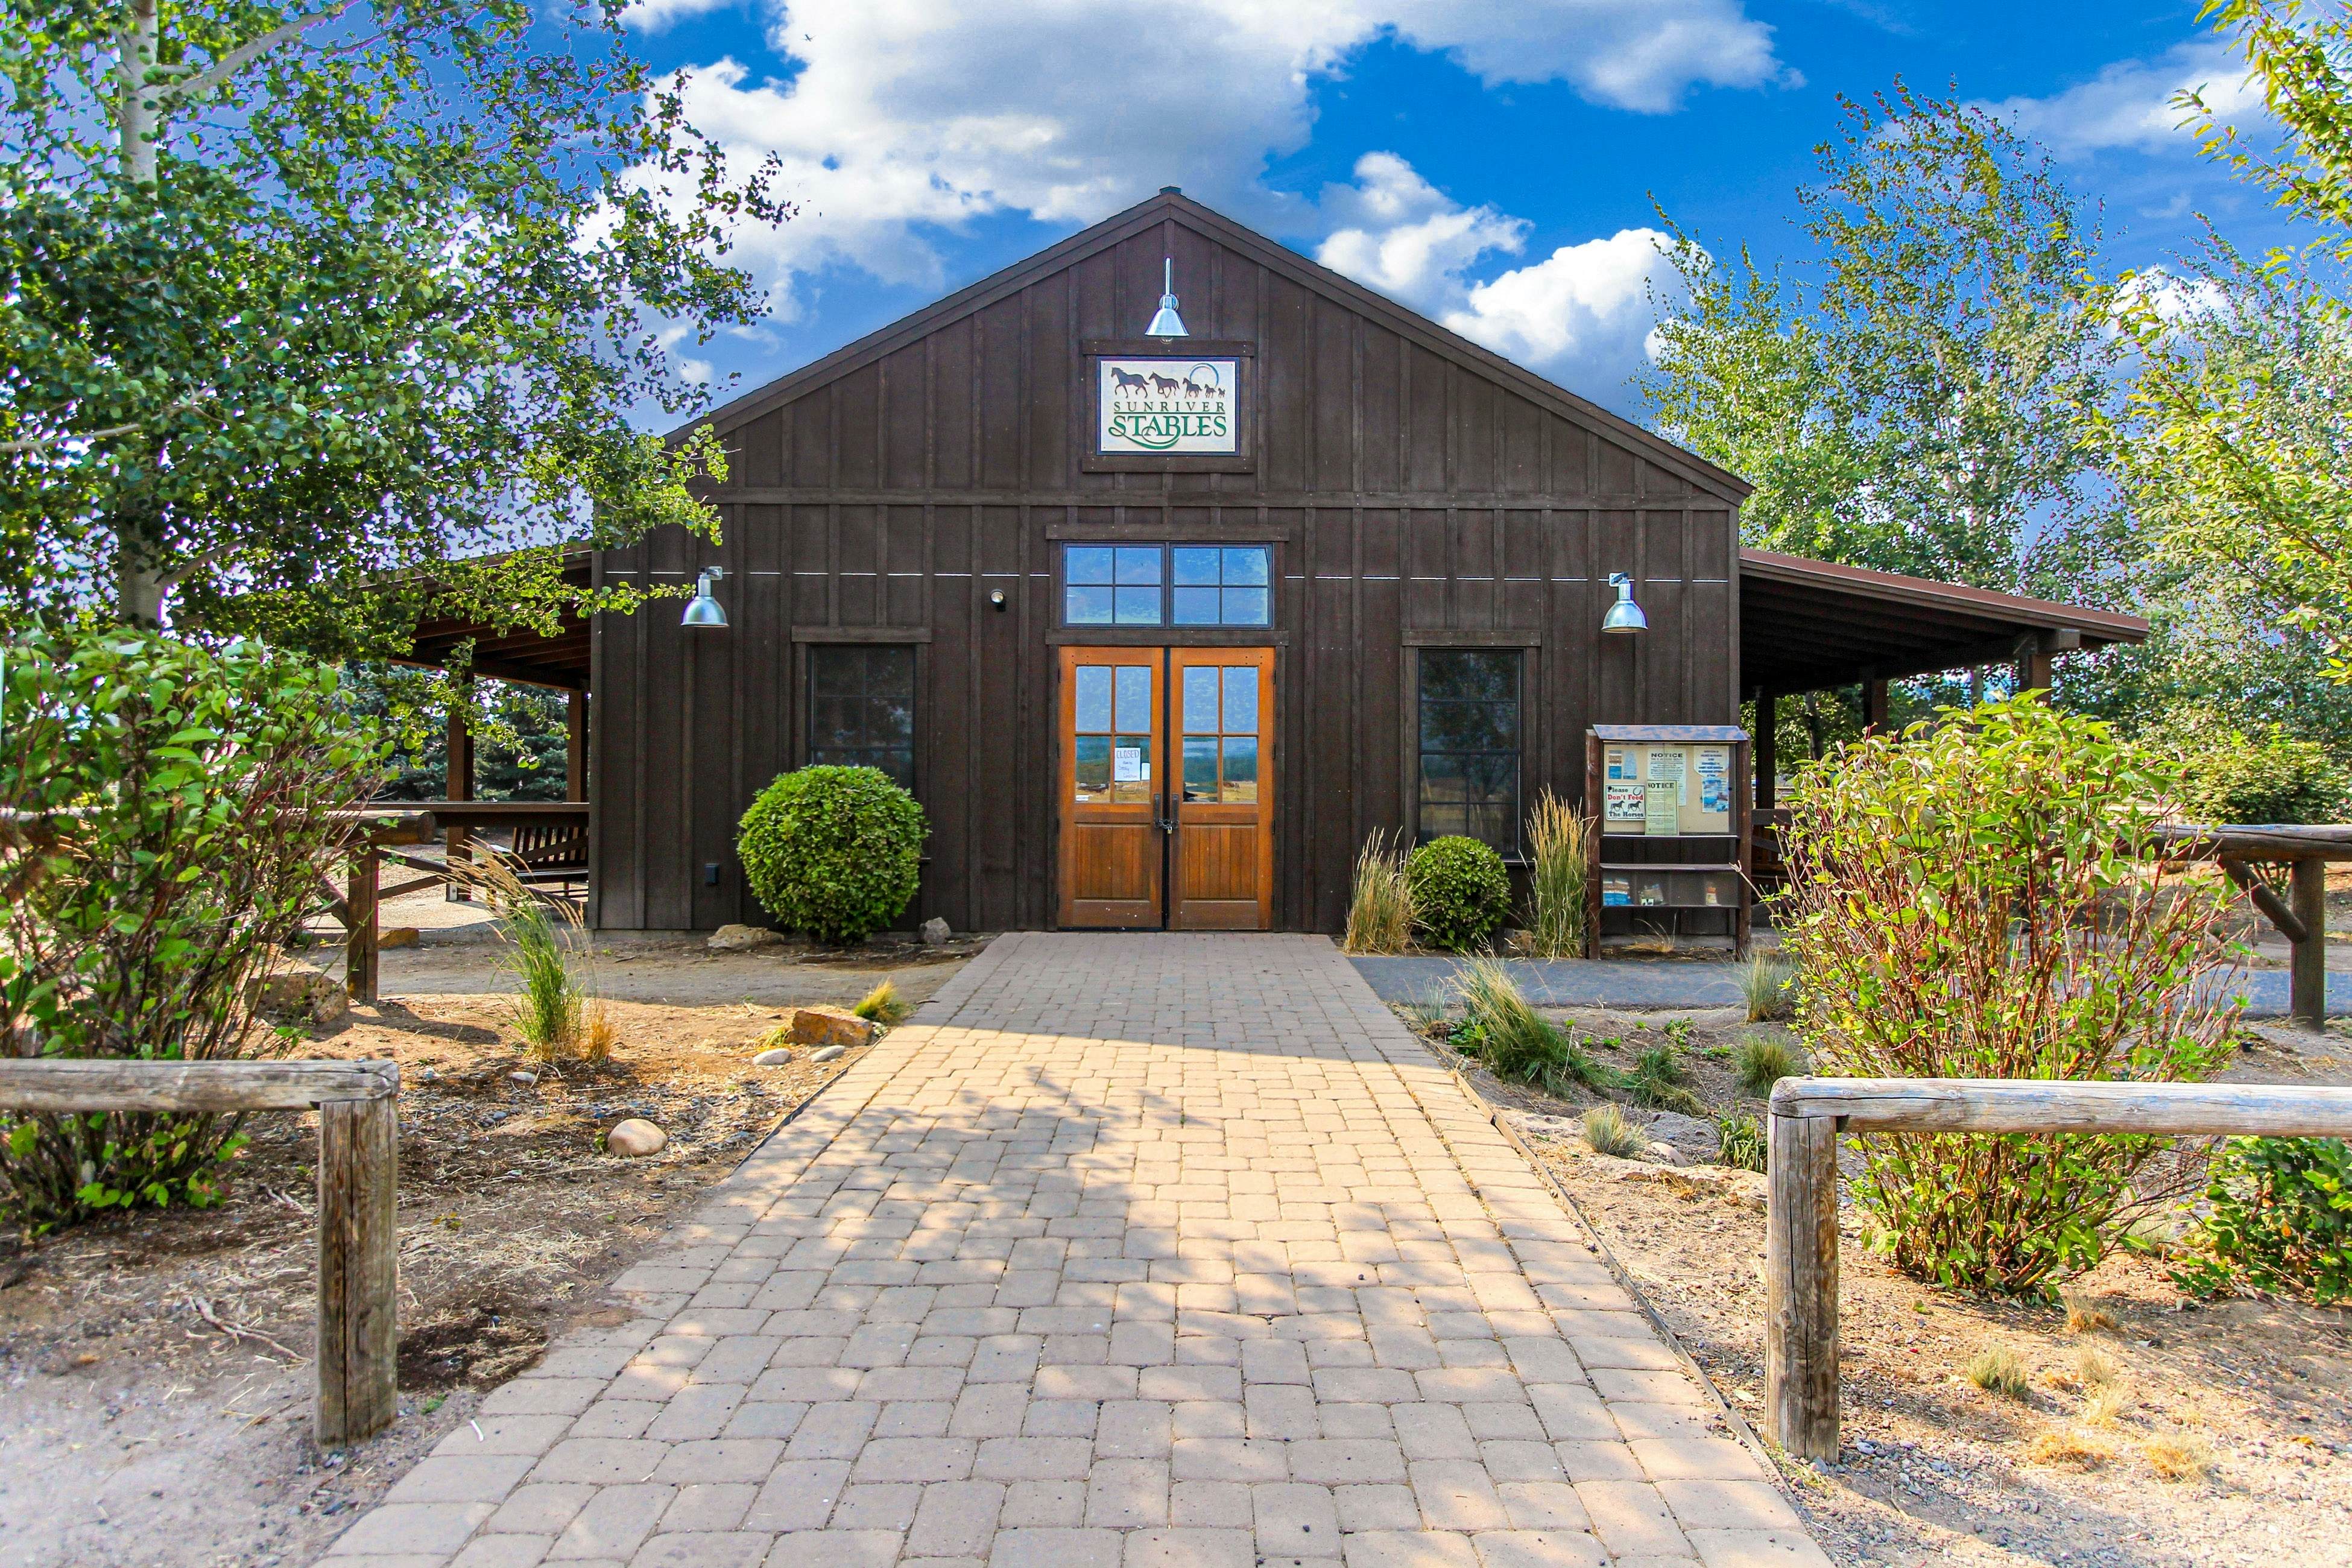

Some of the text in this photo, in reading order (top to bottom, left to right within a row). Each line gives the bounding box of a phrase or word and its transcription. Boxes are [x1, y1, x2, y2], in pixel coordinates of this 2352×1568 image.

[1114, 401, 1225, 412] SUNRIVER
[1108, 415, 1227, 449] STABLES
[1116, 750, 1140, 759] CLOSED
